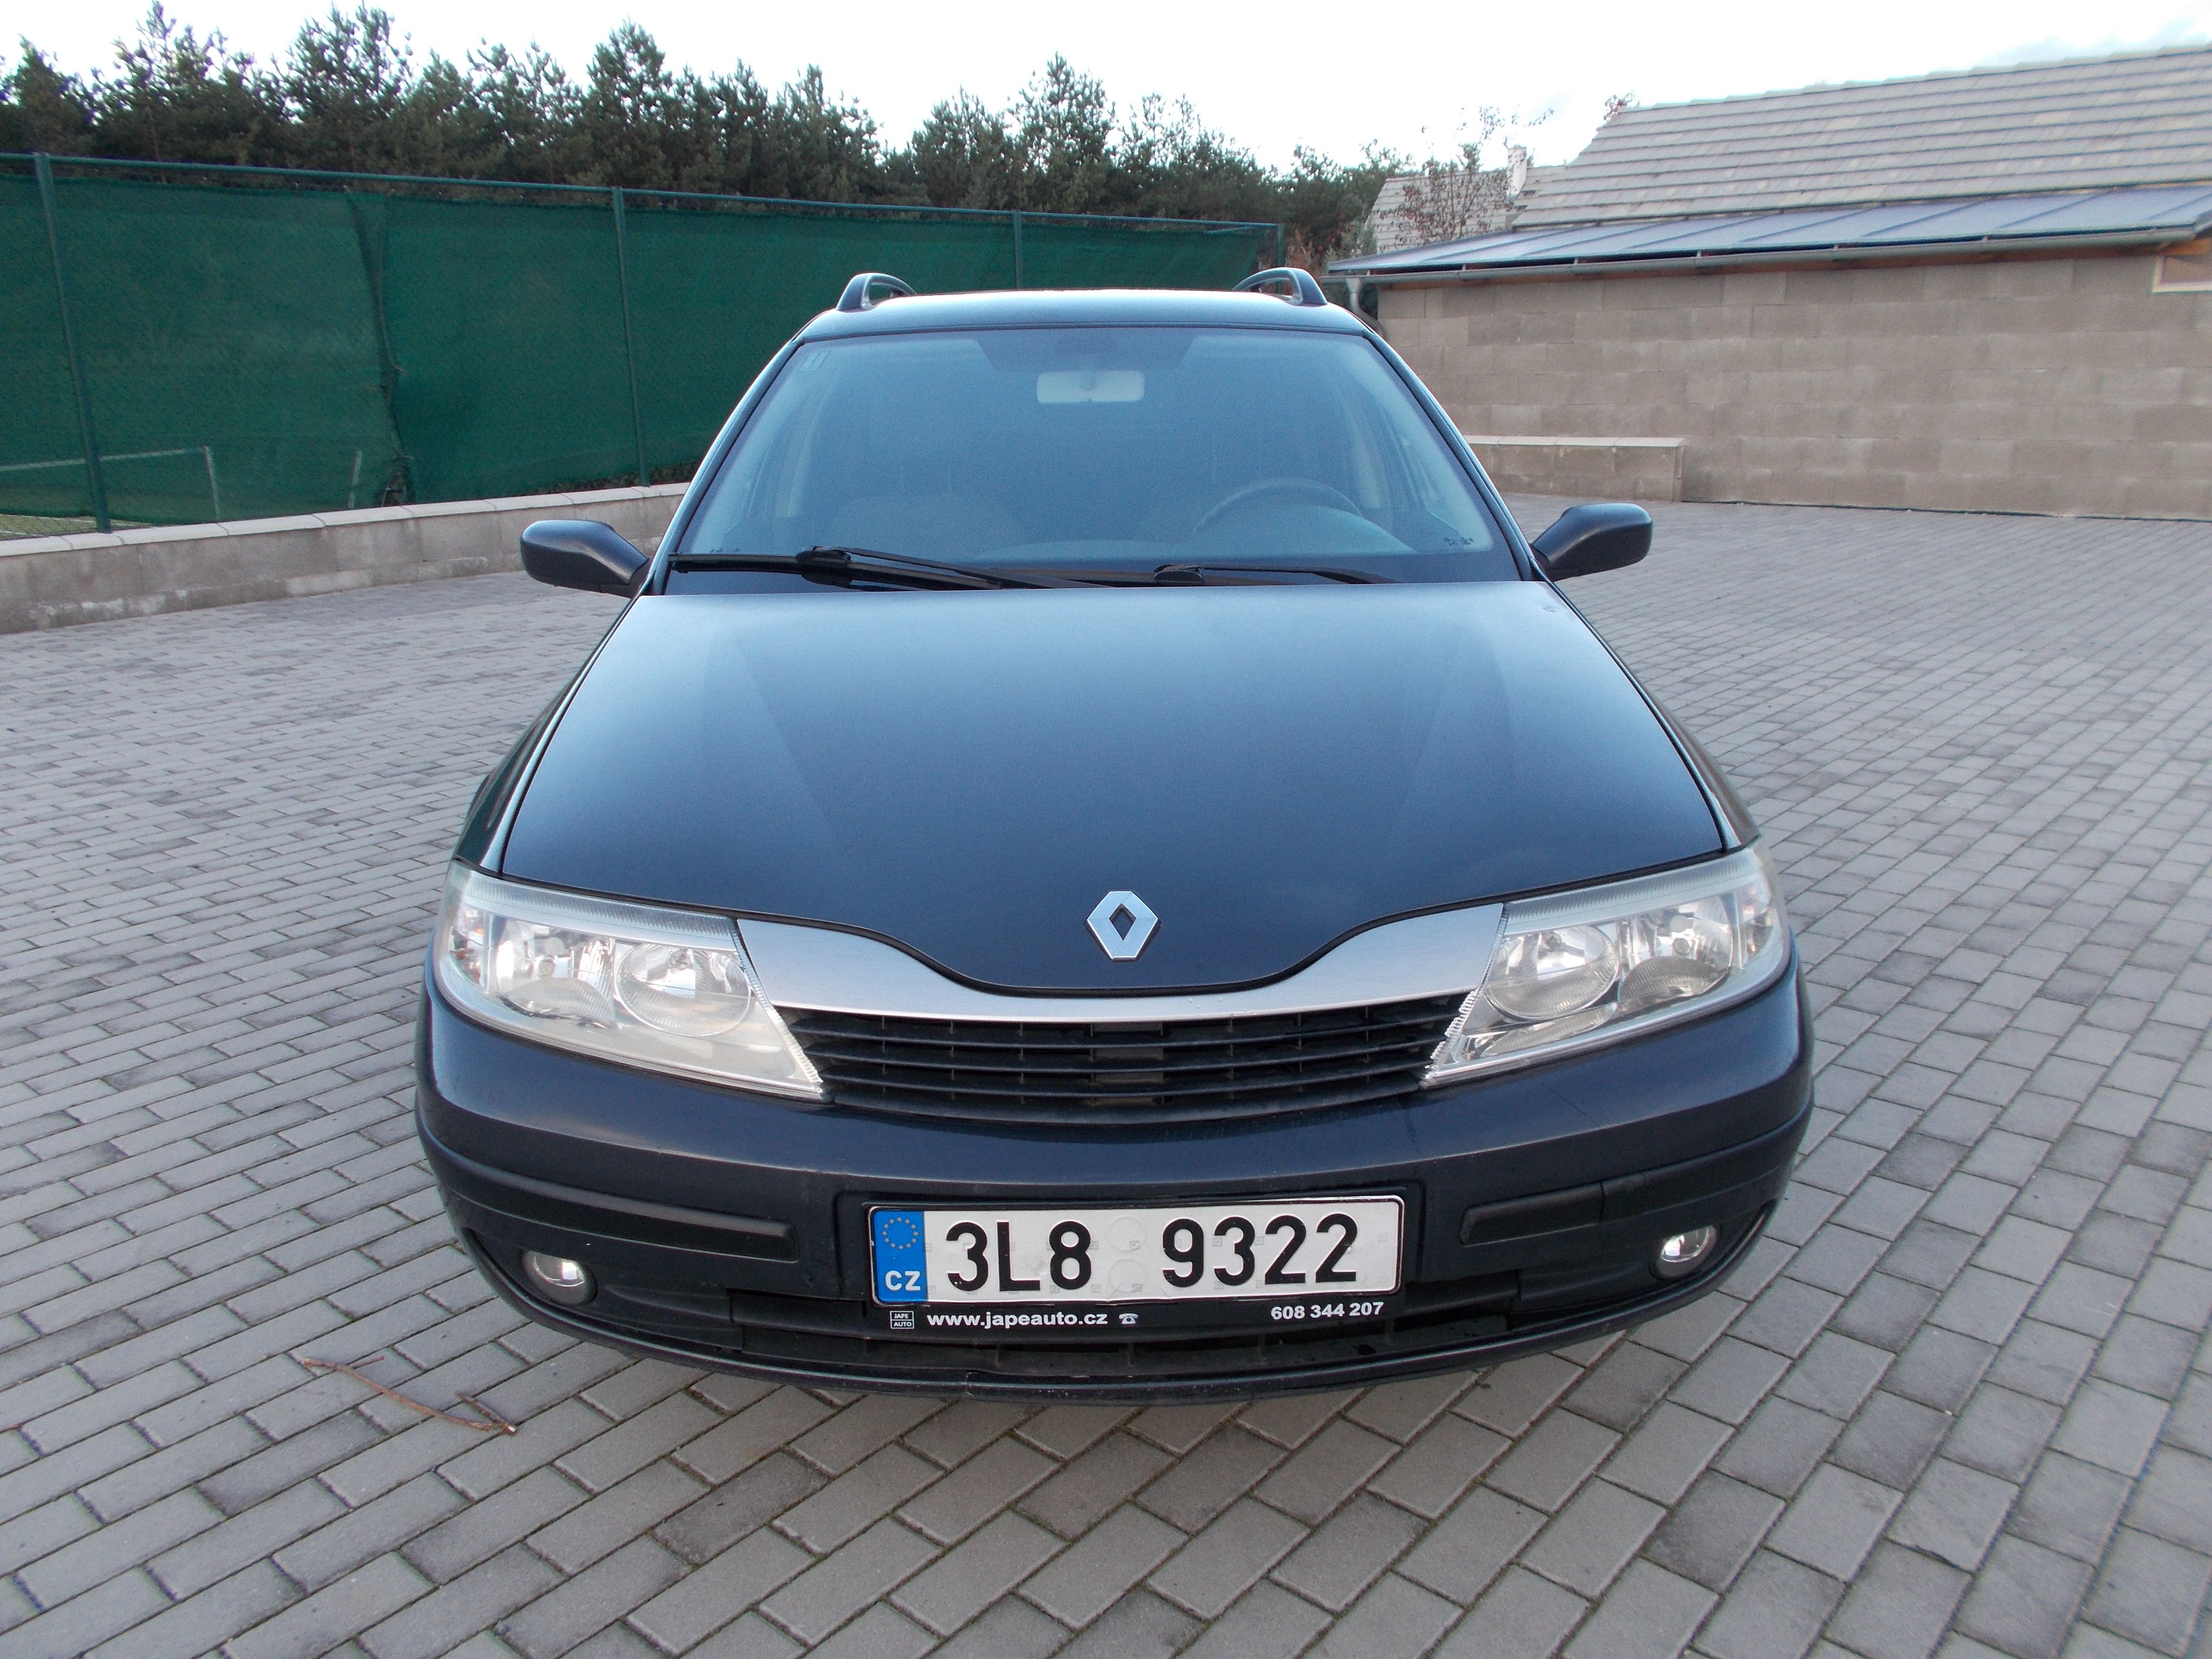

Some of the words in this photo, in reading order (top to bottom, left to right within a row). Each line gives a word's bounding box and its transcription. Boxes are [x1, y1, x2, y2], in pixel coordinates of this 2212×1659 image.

[946, 1221, 1092, 1291] 3L8
[1162, 1213, 1358, 1287] 9322
[885, 1270, 921, 1291] CZ
[926, 1311, 1108, 1329] www.japeauto.cz
[1271, 1306, 1305, 1320] 608
[1310, 1303, 1345, 1317] 344
[1349, 1301, 1384, 1316] 207
